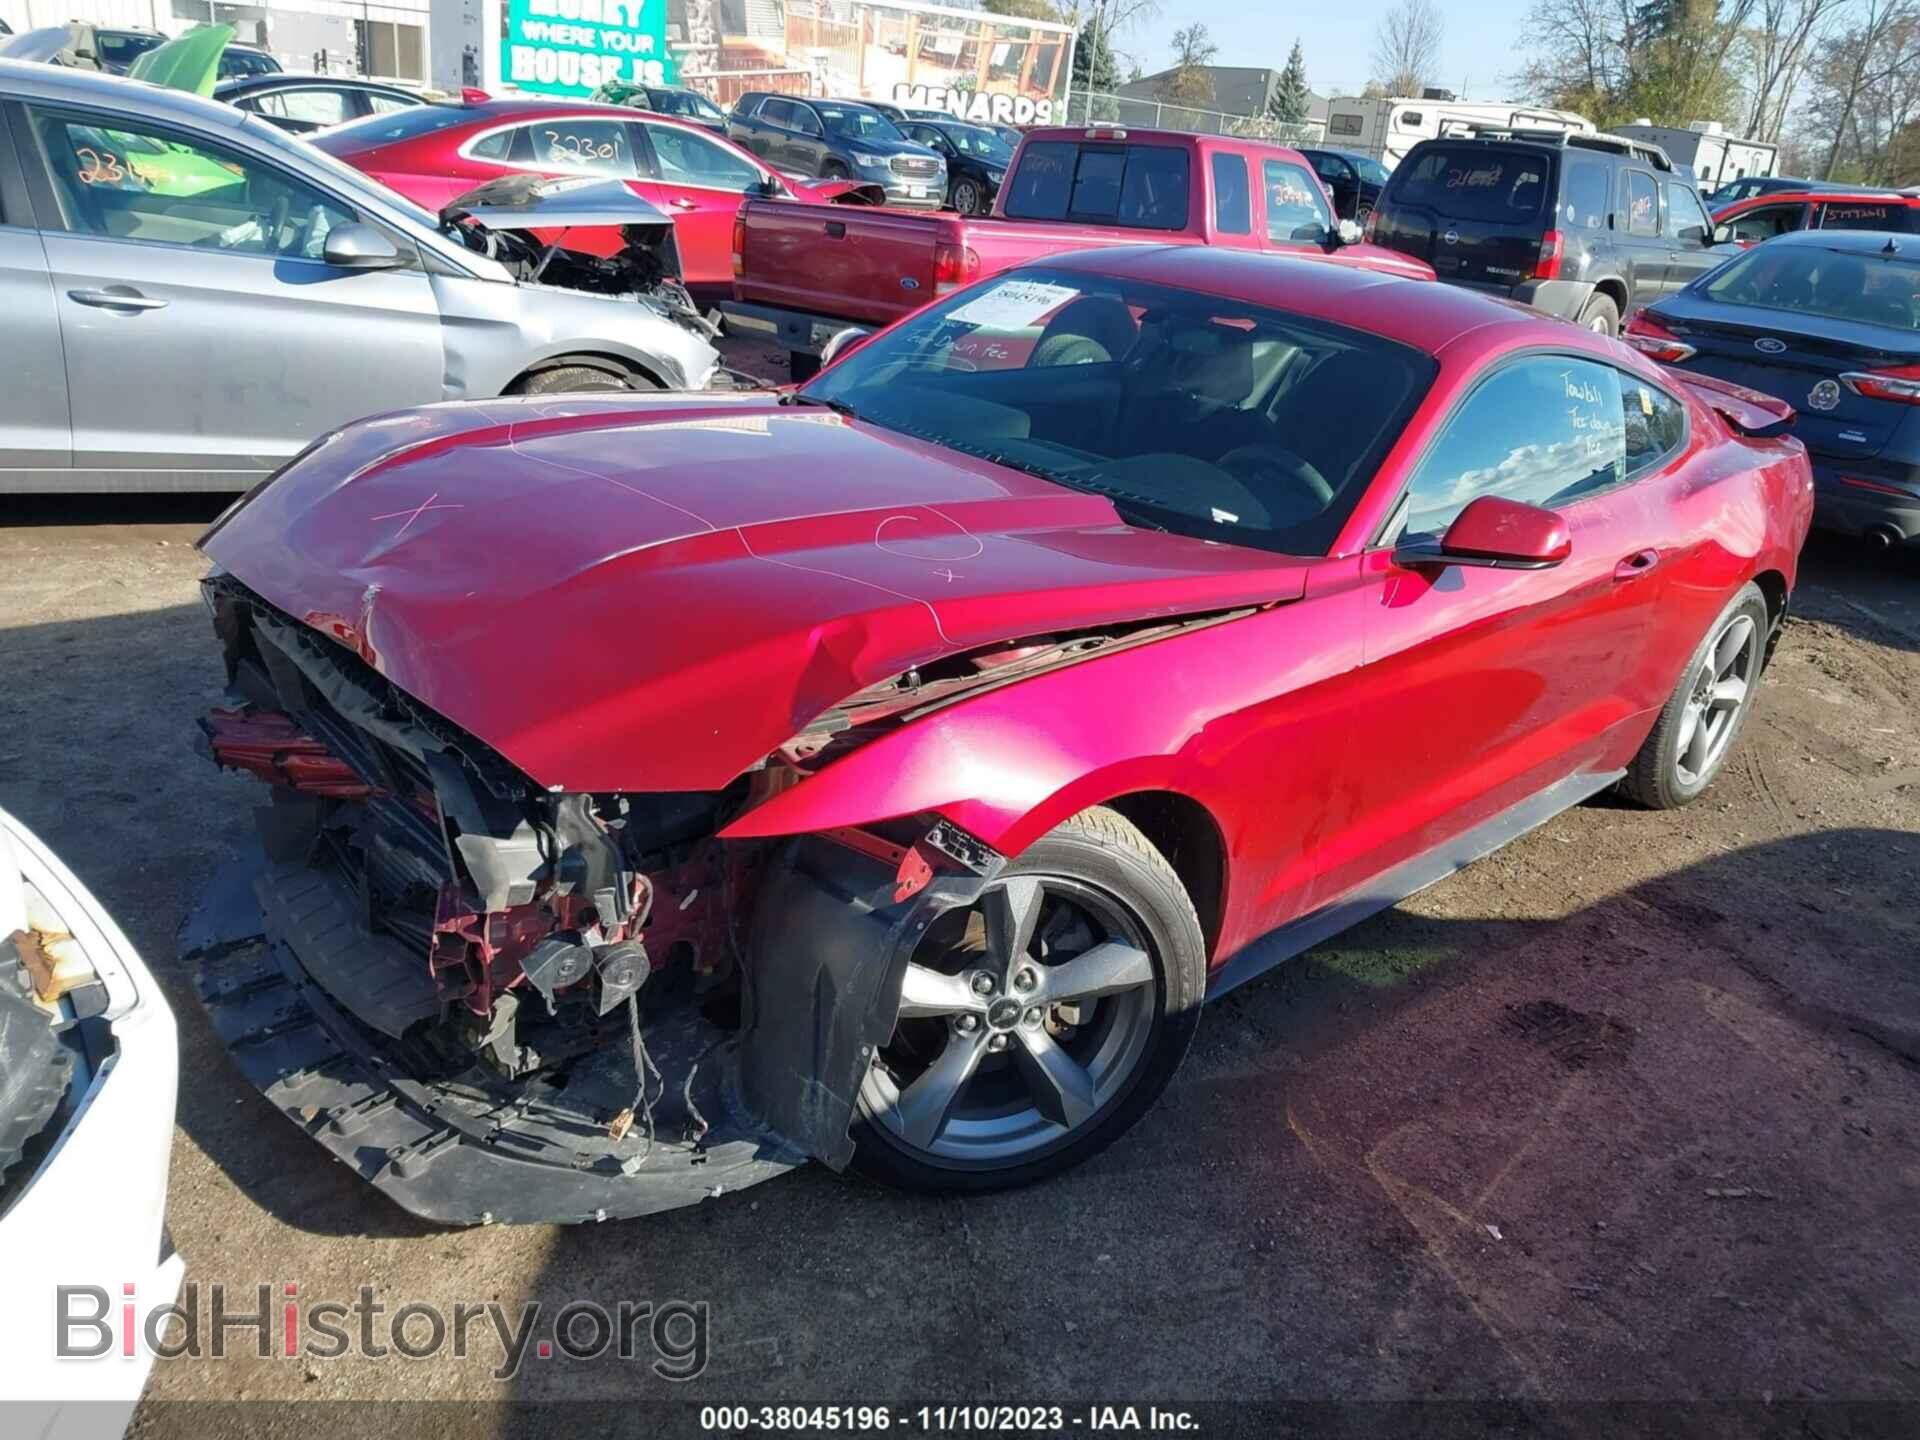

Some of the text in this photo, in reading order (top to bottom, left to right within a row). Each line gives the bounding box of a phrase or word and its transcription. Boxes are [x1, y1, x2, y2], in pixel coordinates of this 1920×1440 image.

[521, 19, 655, 54] WHERE YOUR
[511, 44, 624, 88] HOUSE
[893, 83, 1054, 126] MENARDS
